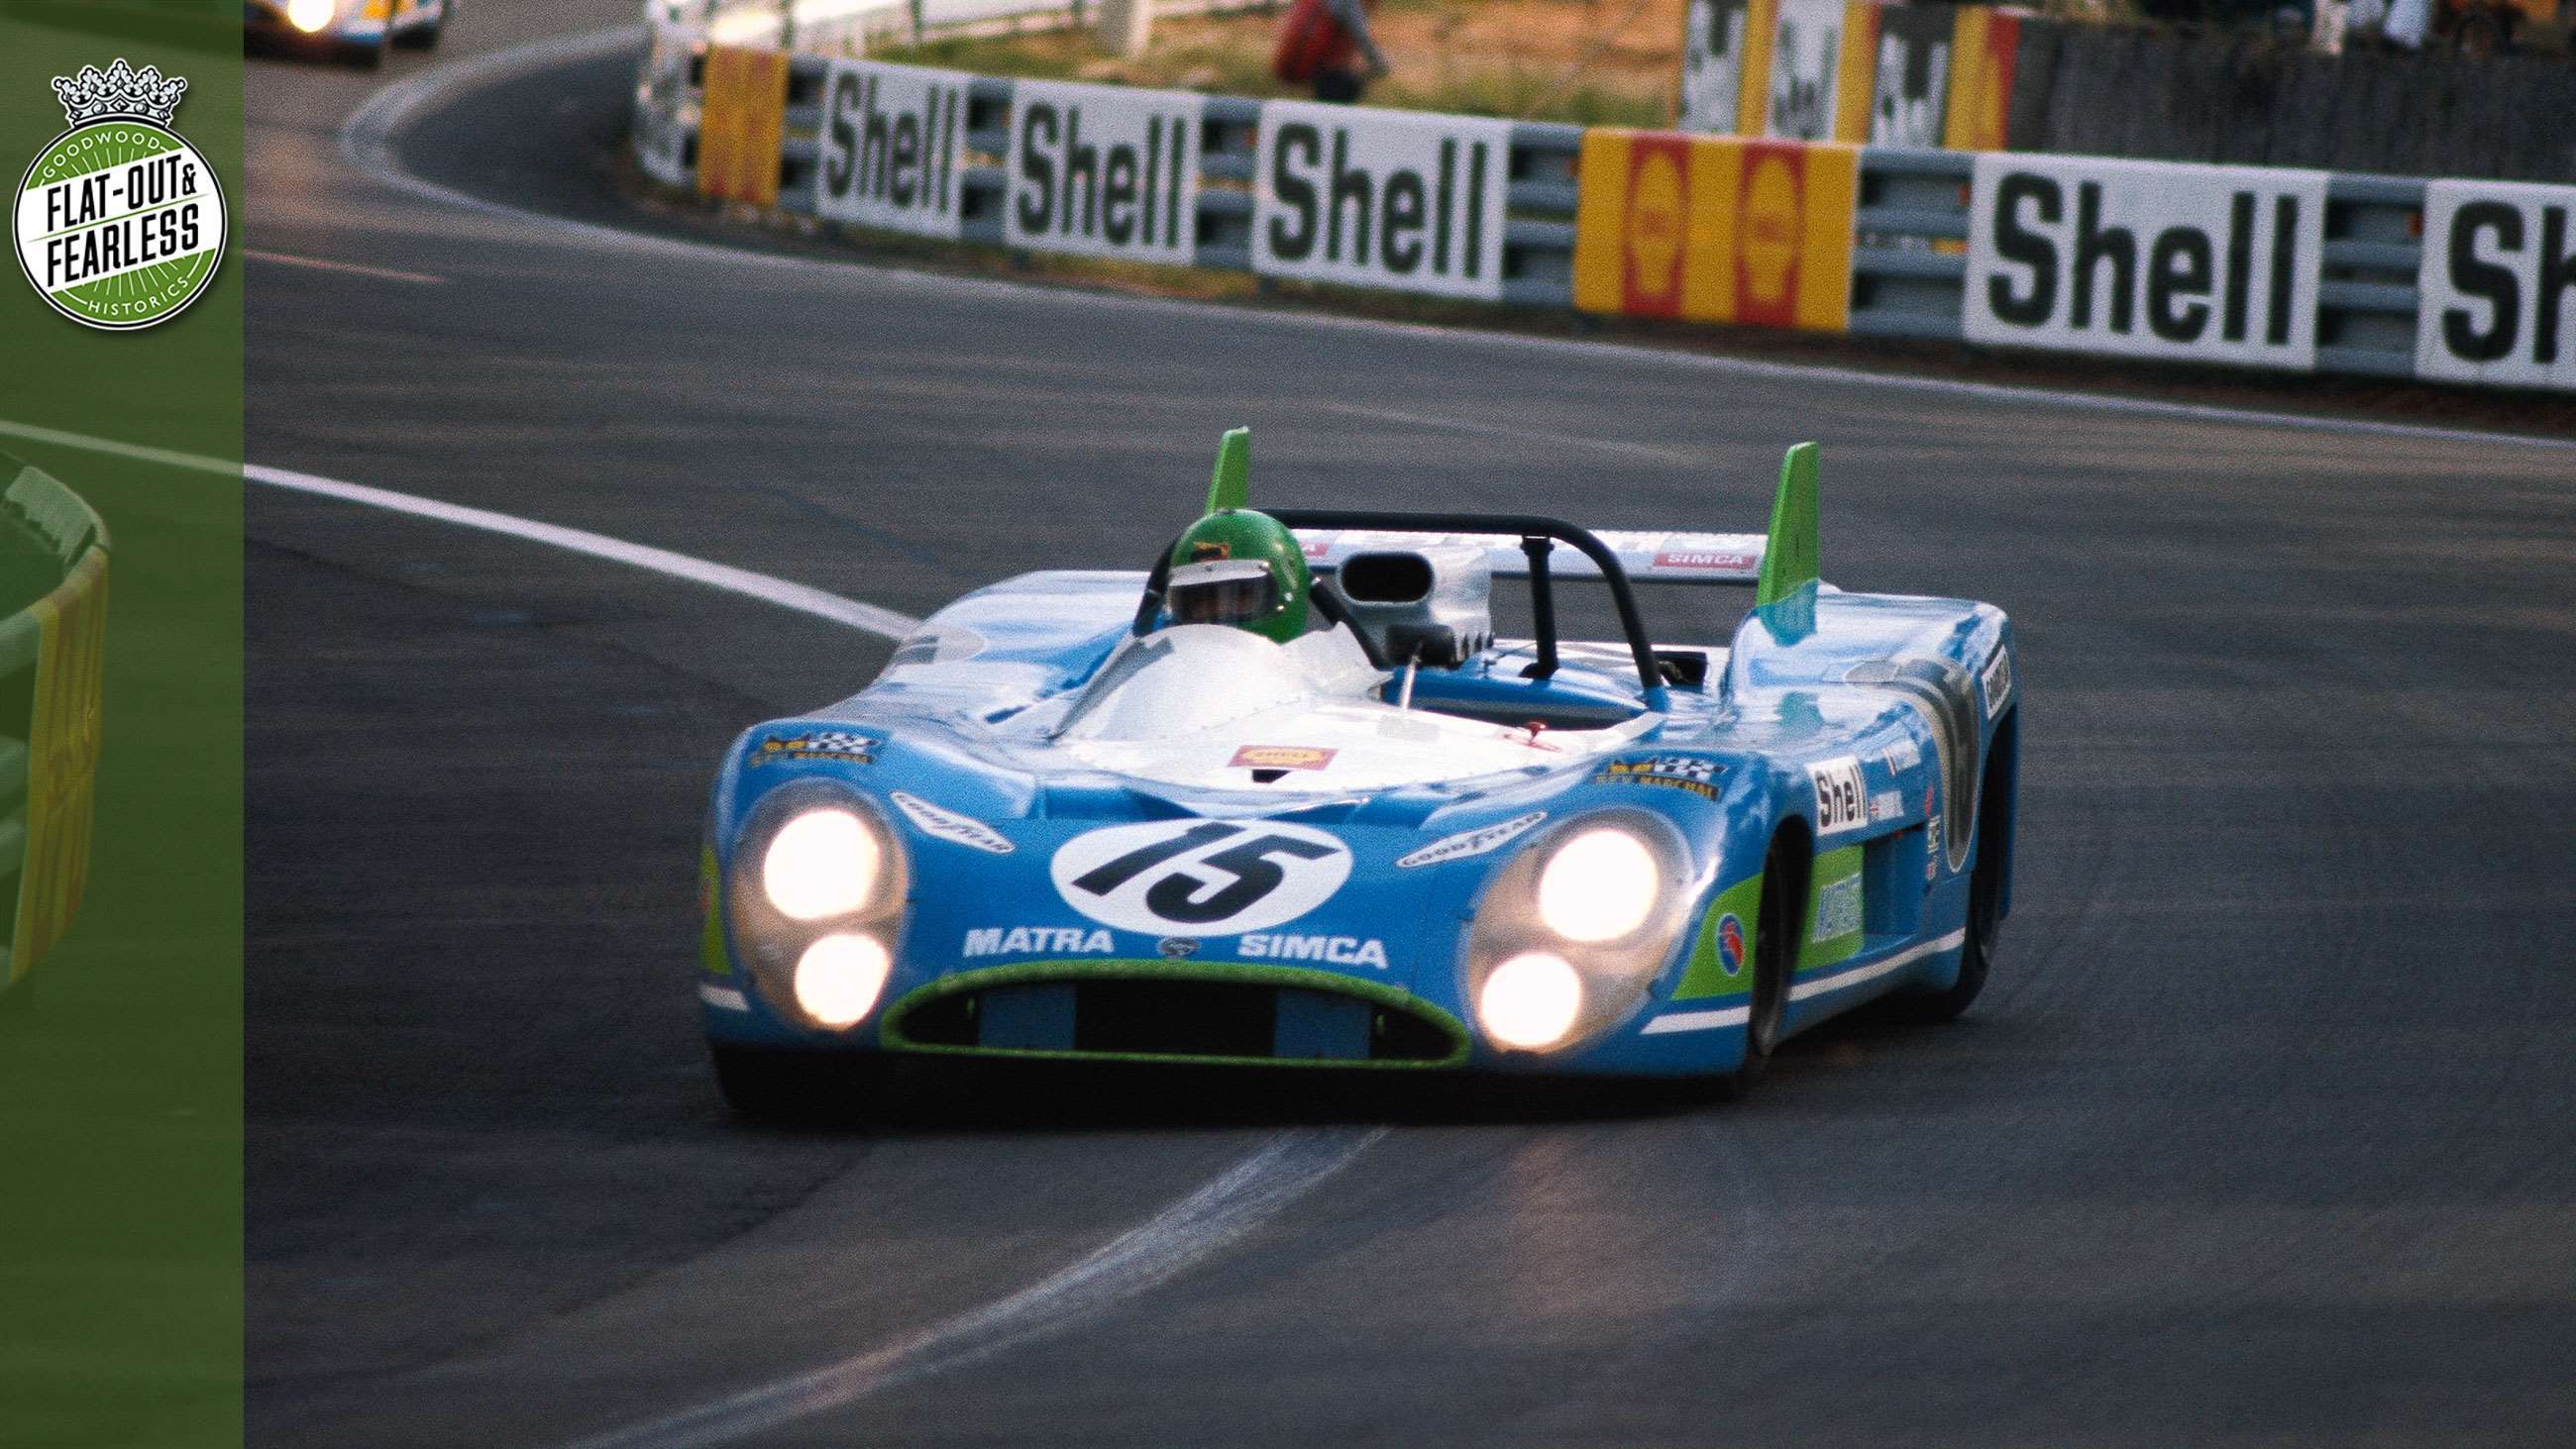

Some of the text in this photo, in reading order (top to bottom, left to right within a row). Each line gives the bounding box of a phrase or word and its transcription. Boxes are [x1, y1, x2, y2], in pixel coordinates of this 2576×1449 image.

[826, 71, 958, 214] Shell
[1018, 102, 1186, 249] Shell
[1267, 123, 1487, 280] Shell
[1986, 170, 2301, 347] Shell
[1666, 553, 1745, 565] SIMCA
[1814, 764, 1868, 829] Shell
[1070, 820, 1341, 924] 15
[961, 927, 1115, 958] MATRA
[1237, 933, 1389, 970] SIMCA
